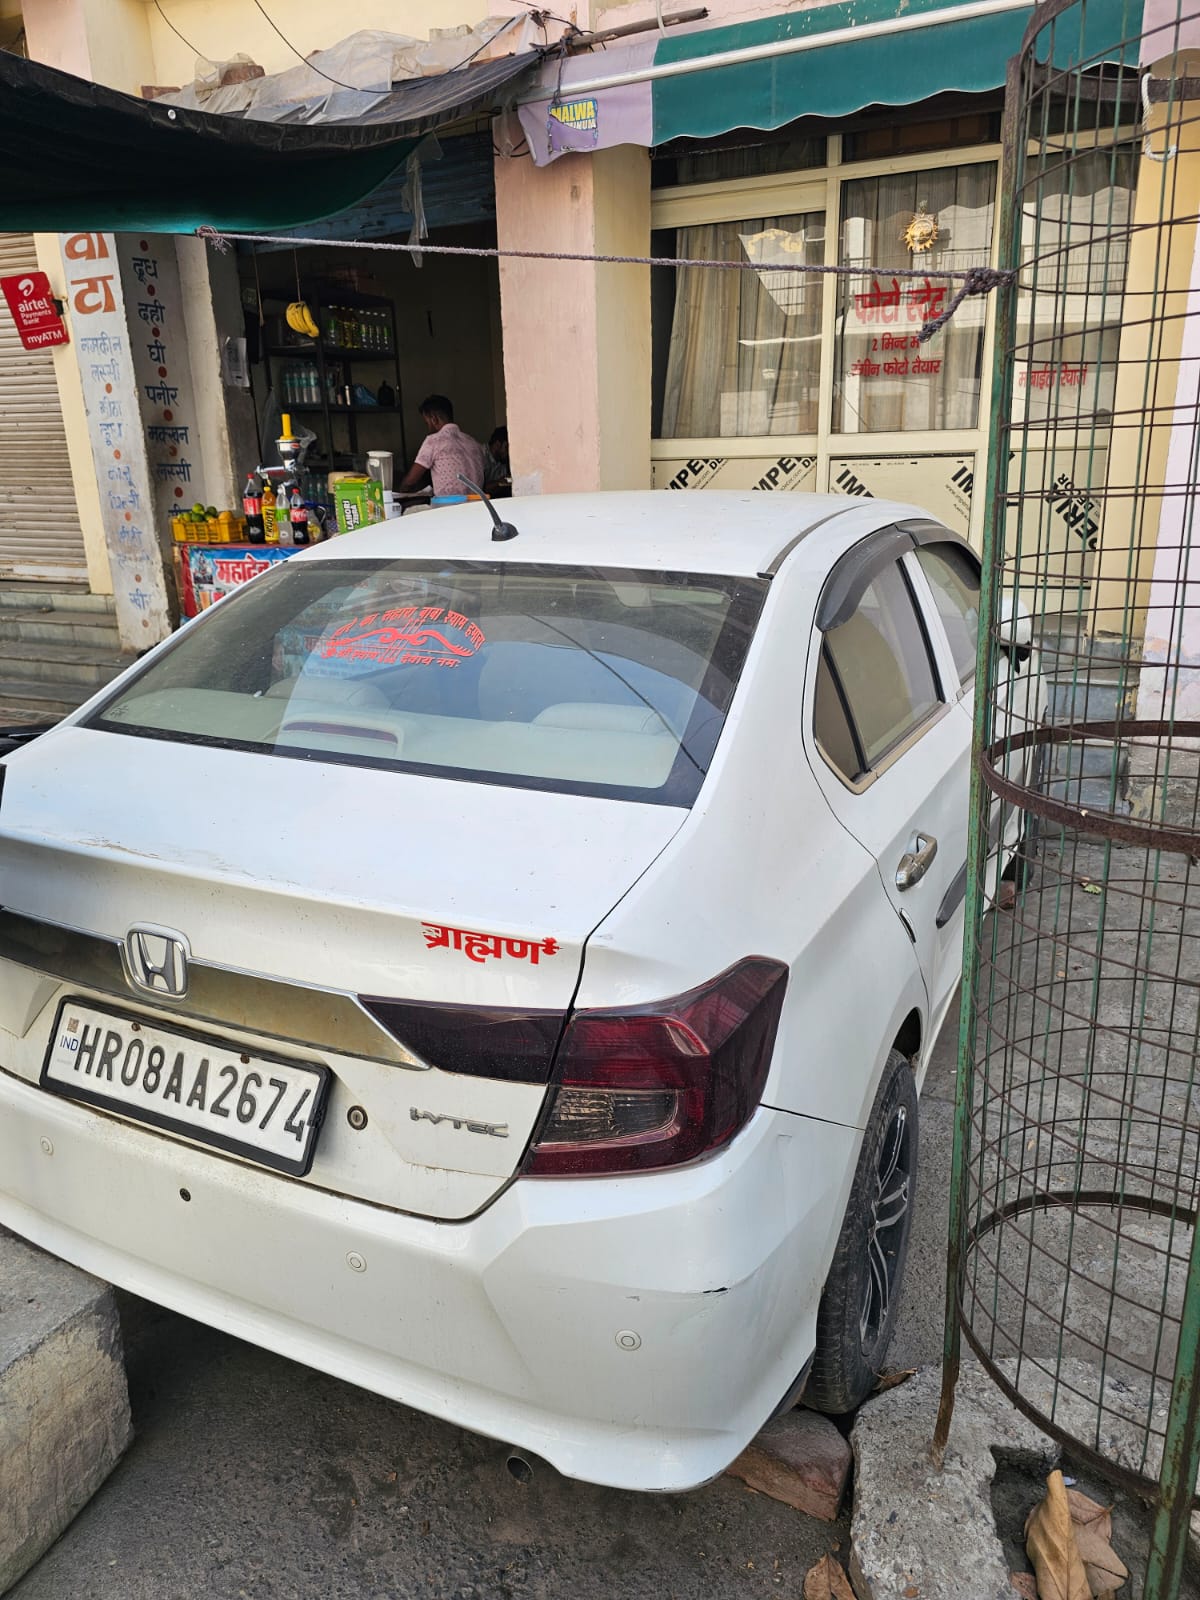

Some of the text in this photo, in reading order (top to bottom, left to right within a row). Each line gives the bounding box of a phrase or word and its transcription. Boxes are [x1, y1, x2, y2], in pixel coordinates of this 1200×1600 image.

[133, 257, 158, 284] दूध
[18, 298, 49, 312] airtel
[21, 310, 52, 319] Payments
[28, 330, 63, 343] myATM
[872, 339, 878, 351] 2
[144, 381, 179, 407] पनीर
[836, 468, 874, 498] IM
[60, 1034, 79, 1051] IND
[74, 1024, 312, 1142] HR08AA2674
